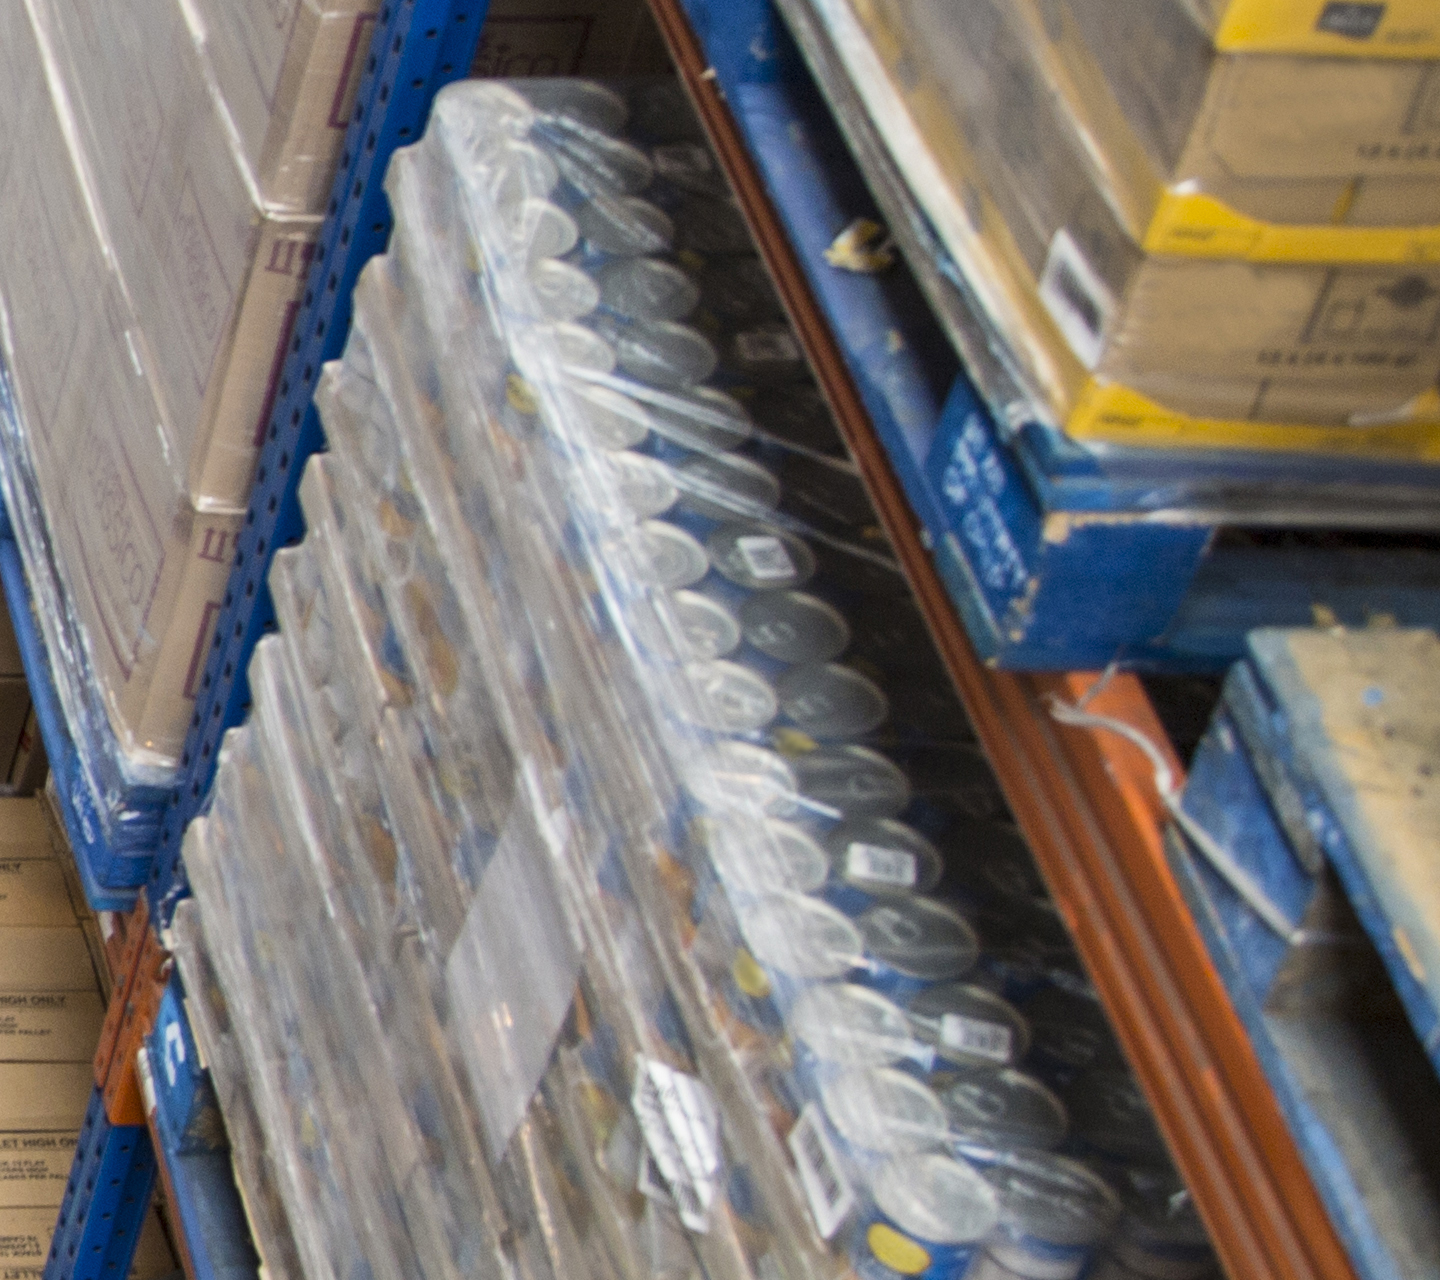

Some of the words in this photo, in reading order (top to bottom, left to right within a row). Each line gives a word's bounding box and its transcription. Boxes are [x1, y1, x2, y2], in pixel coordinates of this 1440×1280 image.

[31, 996, 67, 1006] ONLY
[22, 1139, 55, 1148] HIGH
[3, 1270, 42, 1280] ALLET
